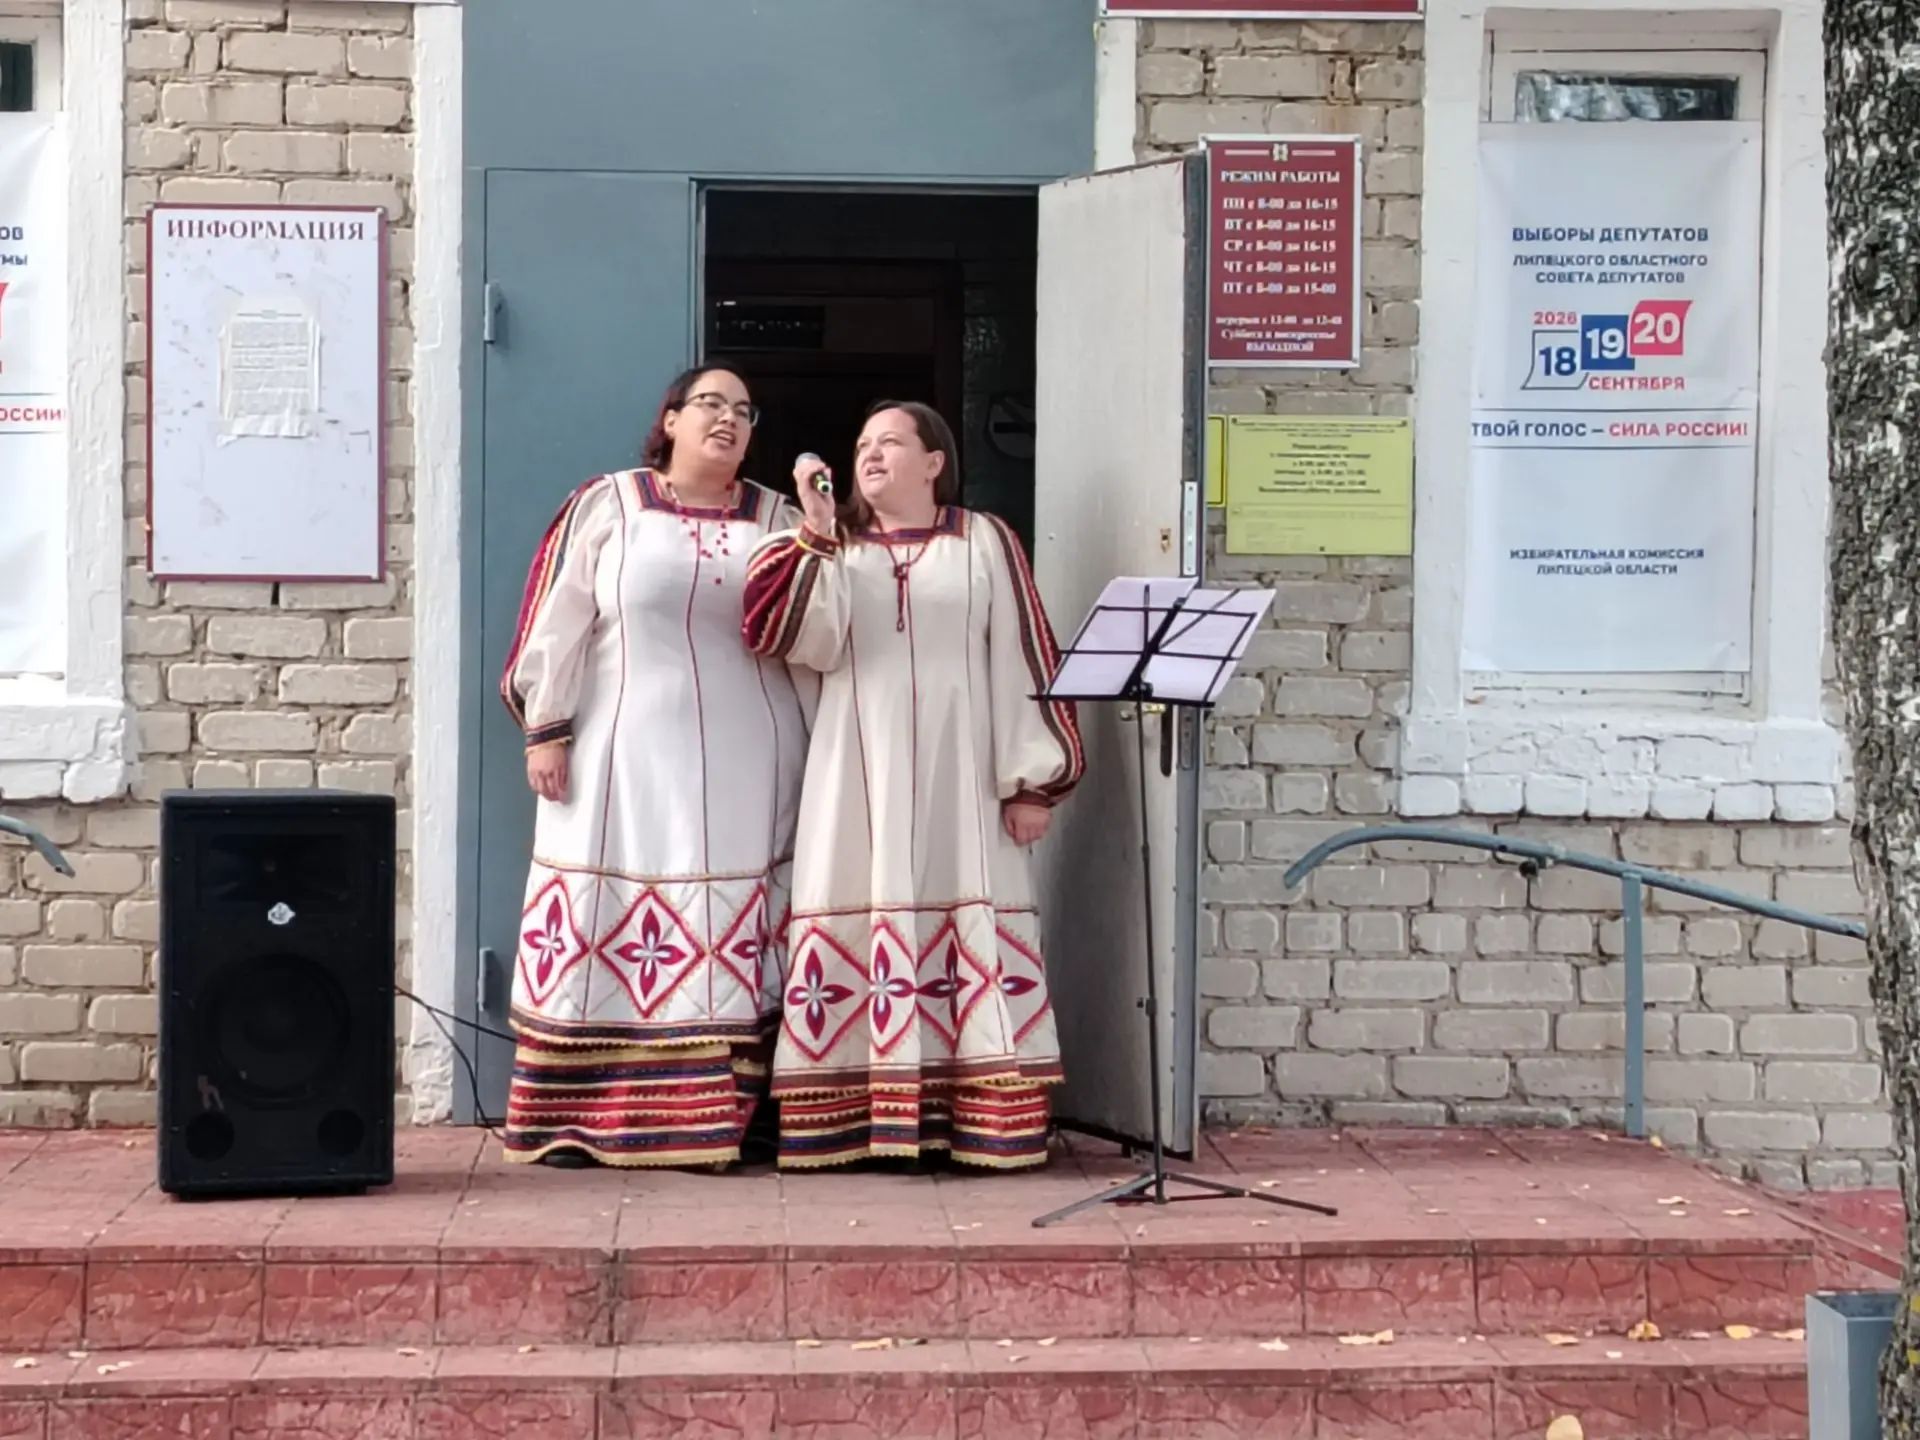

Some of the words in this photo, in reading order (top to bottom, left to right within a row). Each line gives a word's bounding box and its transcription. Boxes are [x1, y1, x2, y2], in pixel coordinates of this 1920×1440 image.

[1221, 171, 1276, 183] РЕЖИМ
[1280, 171, 1340, 183] РАБОТЫ
[1286, 201, 1301, 210] до
[167, 219, 364, 241] ИНФОРМАЦИЯ
[1223, 219, 1243, 230] ВТ
[1285, 222, 1300, 231] до
[1512, 228, 1594, 241] ВЫБОРЫ
[1599, 228, 1708, 243] ДЕПУТАТОВ
[1223, 240, 1243, 251] СР
[1285, 243, 1300, 252] до
[1223, 261, 1243, 272] ЧТ
[1285, 264, 1300, 273] до
[1513, 255, 1605, 268] ЛИПЕЦКОГО
[1608, 255, 1708, 266] ОБЛАСТНОГО
[1536, 272, 1594, 283] СОВЕТА
[1597, 272, 1685, 284] ДЕПУТАТОВ
[1285, 285, 1300, 294] до
[1533, 312, 1577, 325] 2026
[1633, 312, 1680, 344] 20
[1586, 328, 1624, 359] 19
[1539, 346, 1576, 376] 18
[1588, 377, 1685, 390] СЕНТЯБРЯ
[1471, 420, 1519, 437] ТВОЙ
[1524, 423, 1587, 437] ГОЛОС
[1609, 422, 1660, 436] СИЛА
[1666, 422, 1748, 436] РОССИИ!
[1510, 549, 1625, 559] ИЗБИРАТЕЛЬНАЯ
[1629, 549, 1704, 559] КОМИССИЯ
[1537, 562, 1612, 575] ЛИПЕЦКОЙ
[1615, 564, 1678, 575] ОБЛАСТИ
